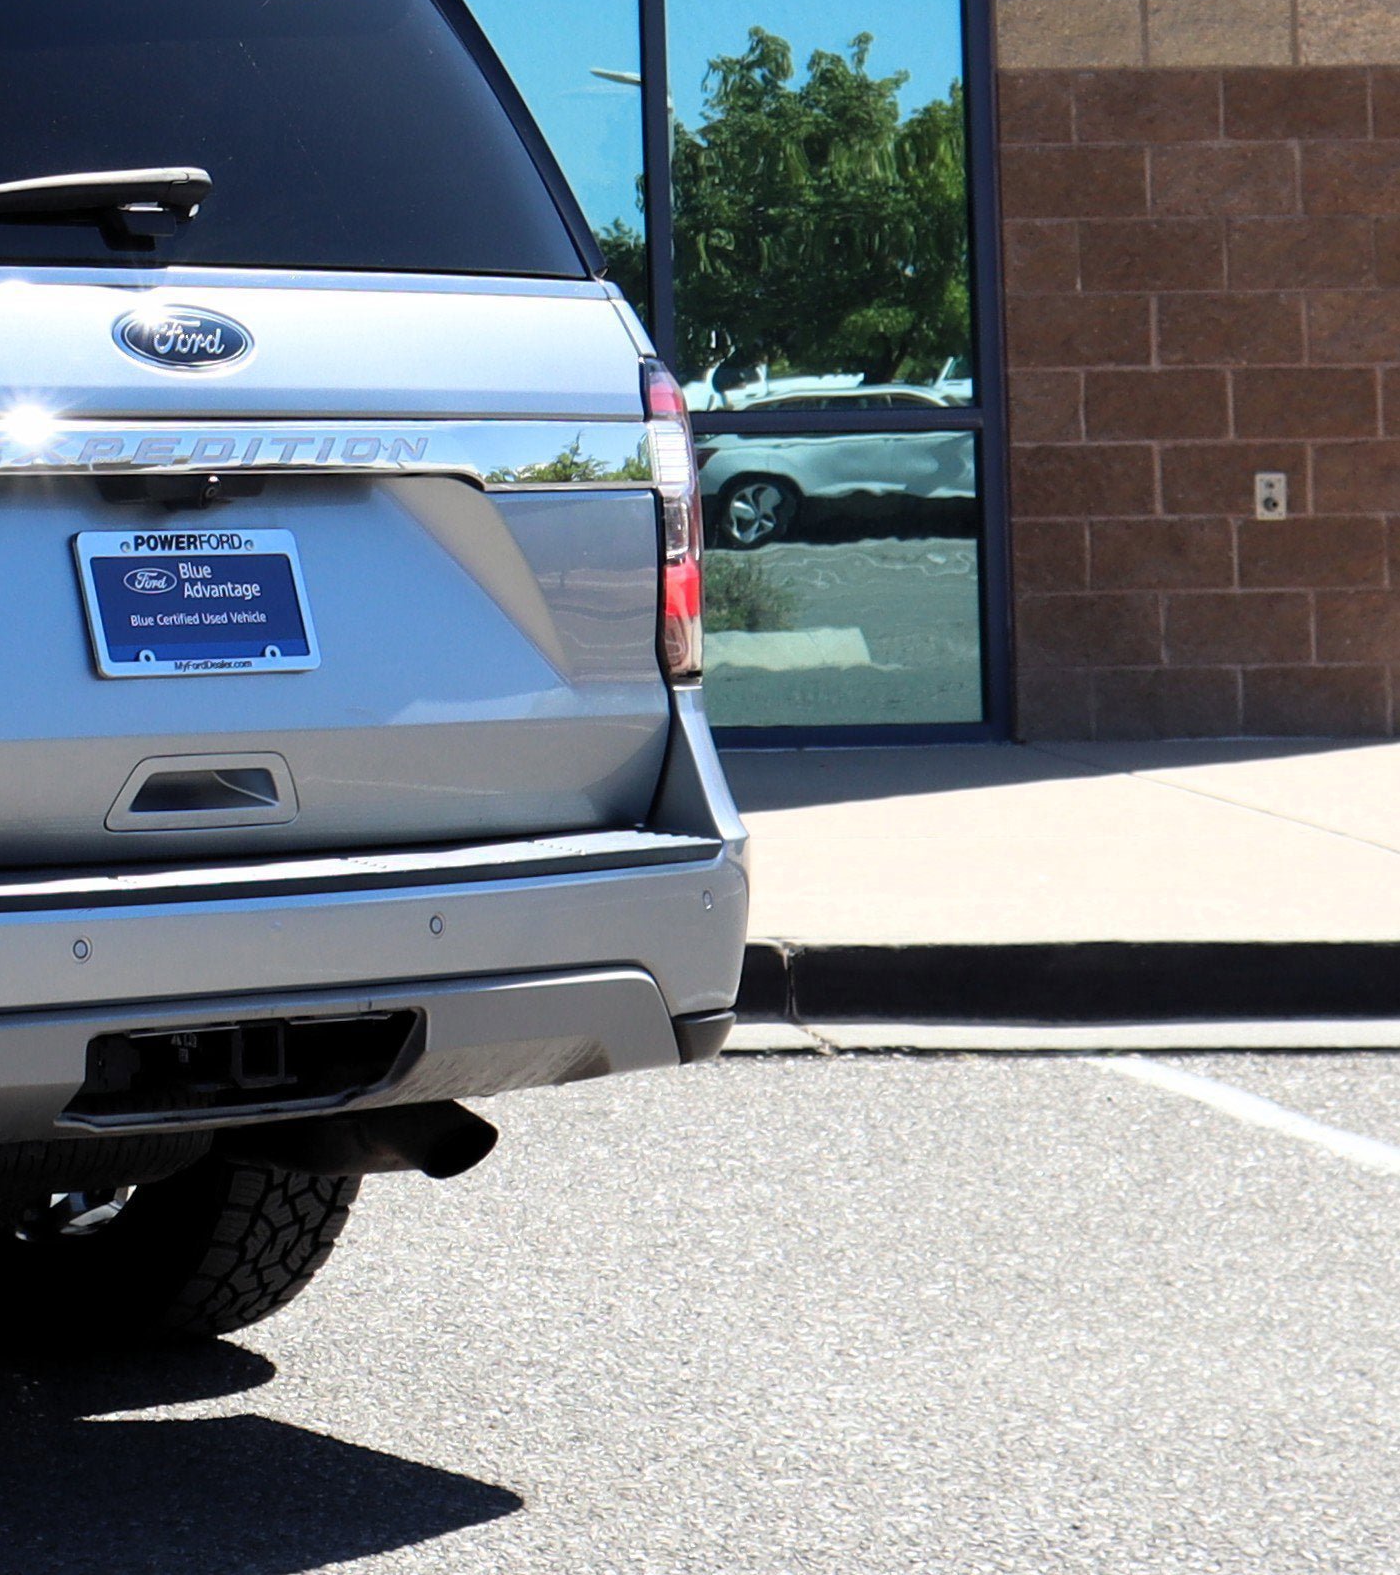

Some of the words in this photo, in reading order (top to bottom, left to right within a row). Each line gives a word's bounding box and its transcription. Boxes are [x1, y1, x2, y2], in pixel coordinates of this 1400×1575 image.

[153, 317, 225, 355] Ford
[178, 562, 212, 579] Blue
[134, 571, 168, 590] Ford
[183, 581, 262, 600] Advantage
[130, 614, 155, 627] Blue
[156, 612, 200, 626] Certified
[201, 611, 228, 624] Used
[230, 610, 267, 624] Vehicle
